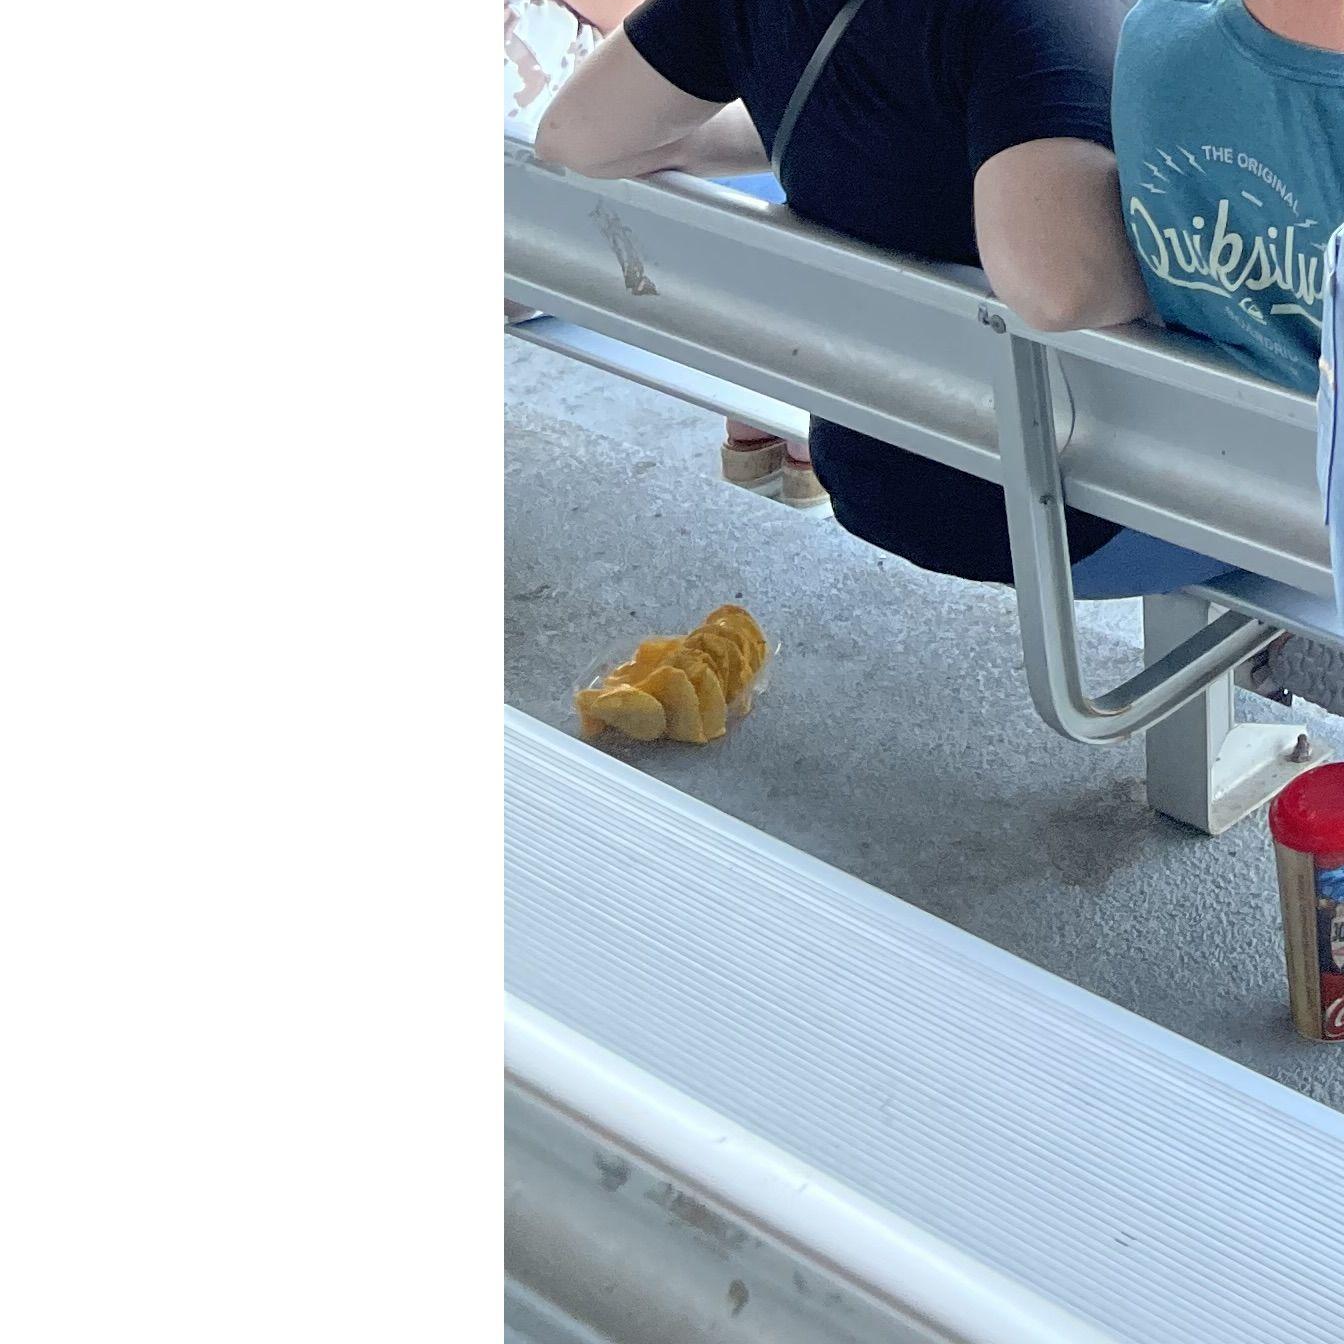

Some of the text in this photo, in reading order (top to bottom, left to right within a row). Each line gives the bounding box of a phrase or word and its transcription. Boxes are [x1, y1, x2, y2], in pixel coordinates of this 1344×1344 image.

[1201, 144, 1300, 214] THE ORIGINAL
[1130, 196, 1324, 306] Quiksilv
